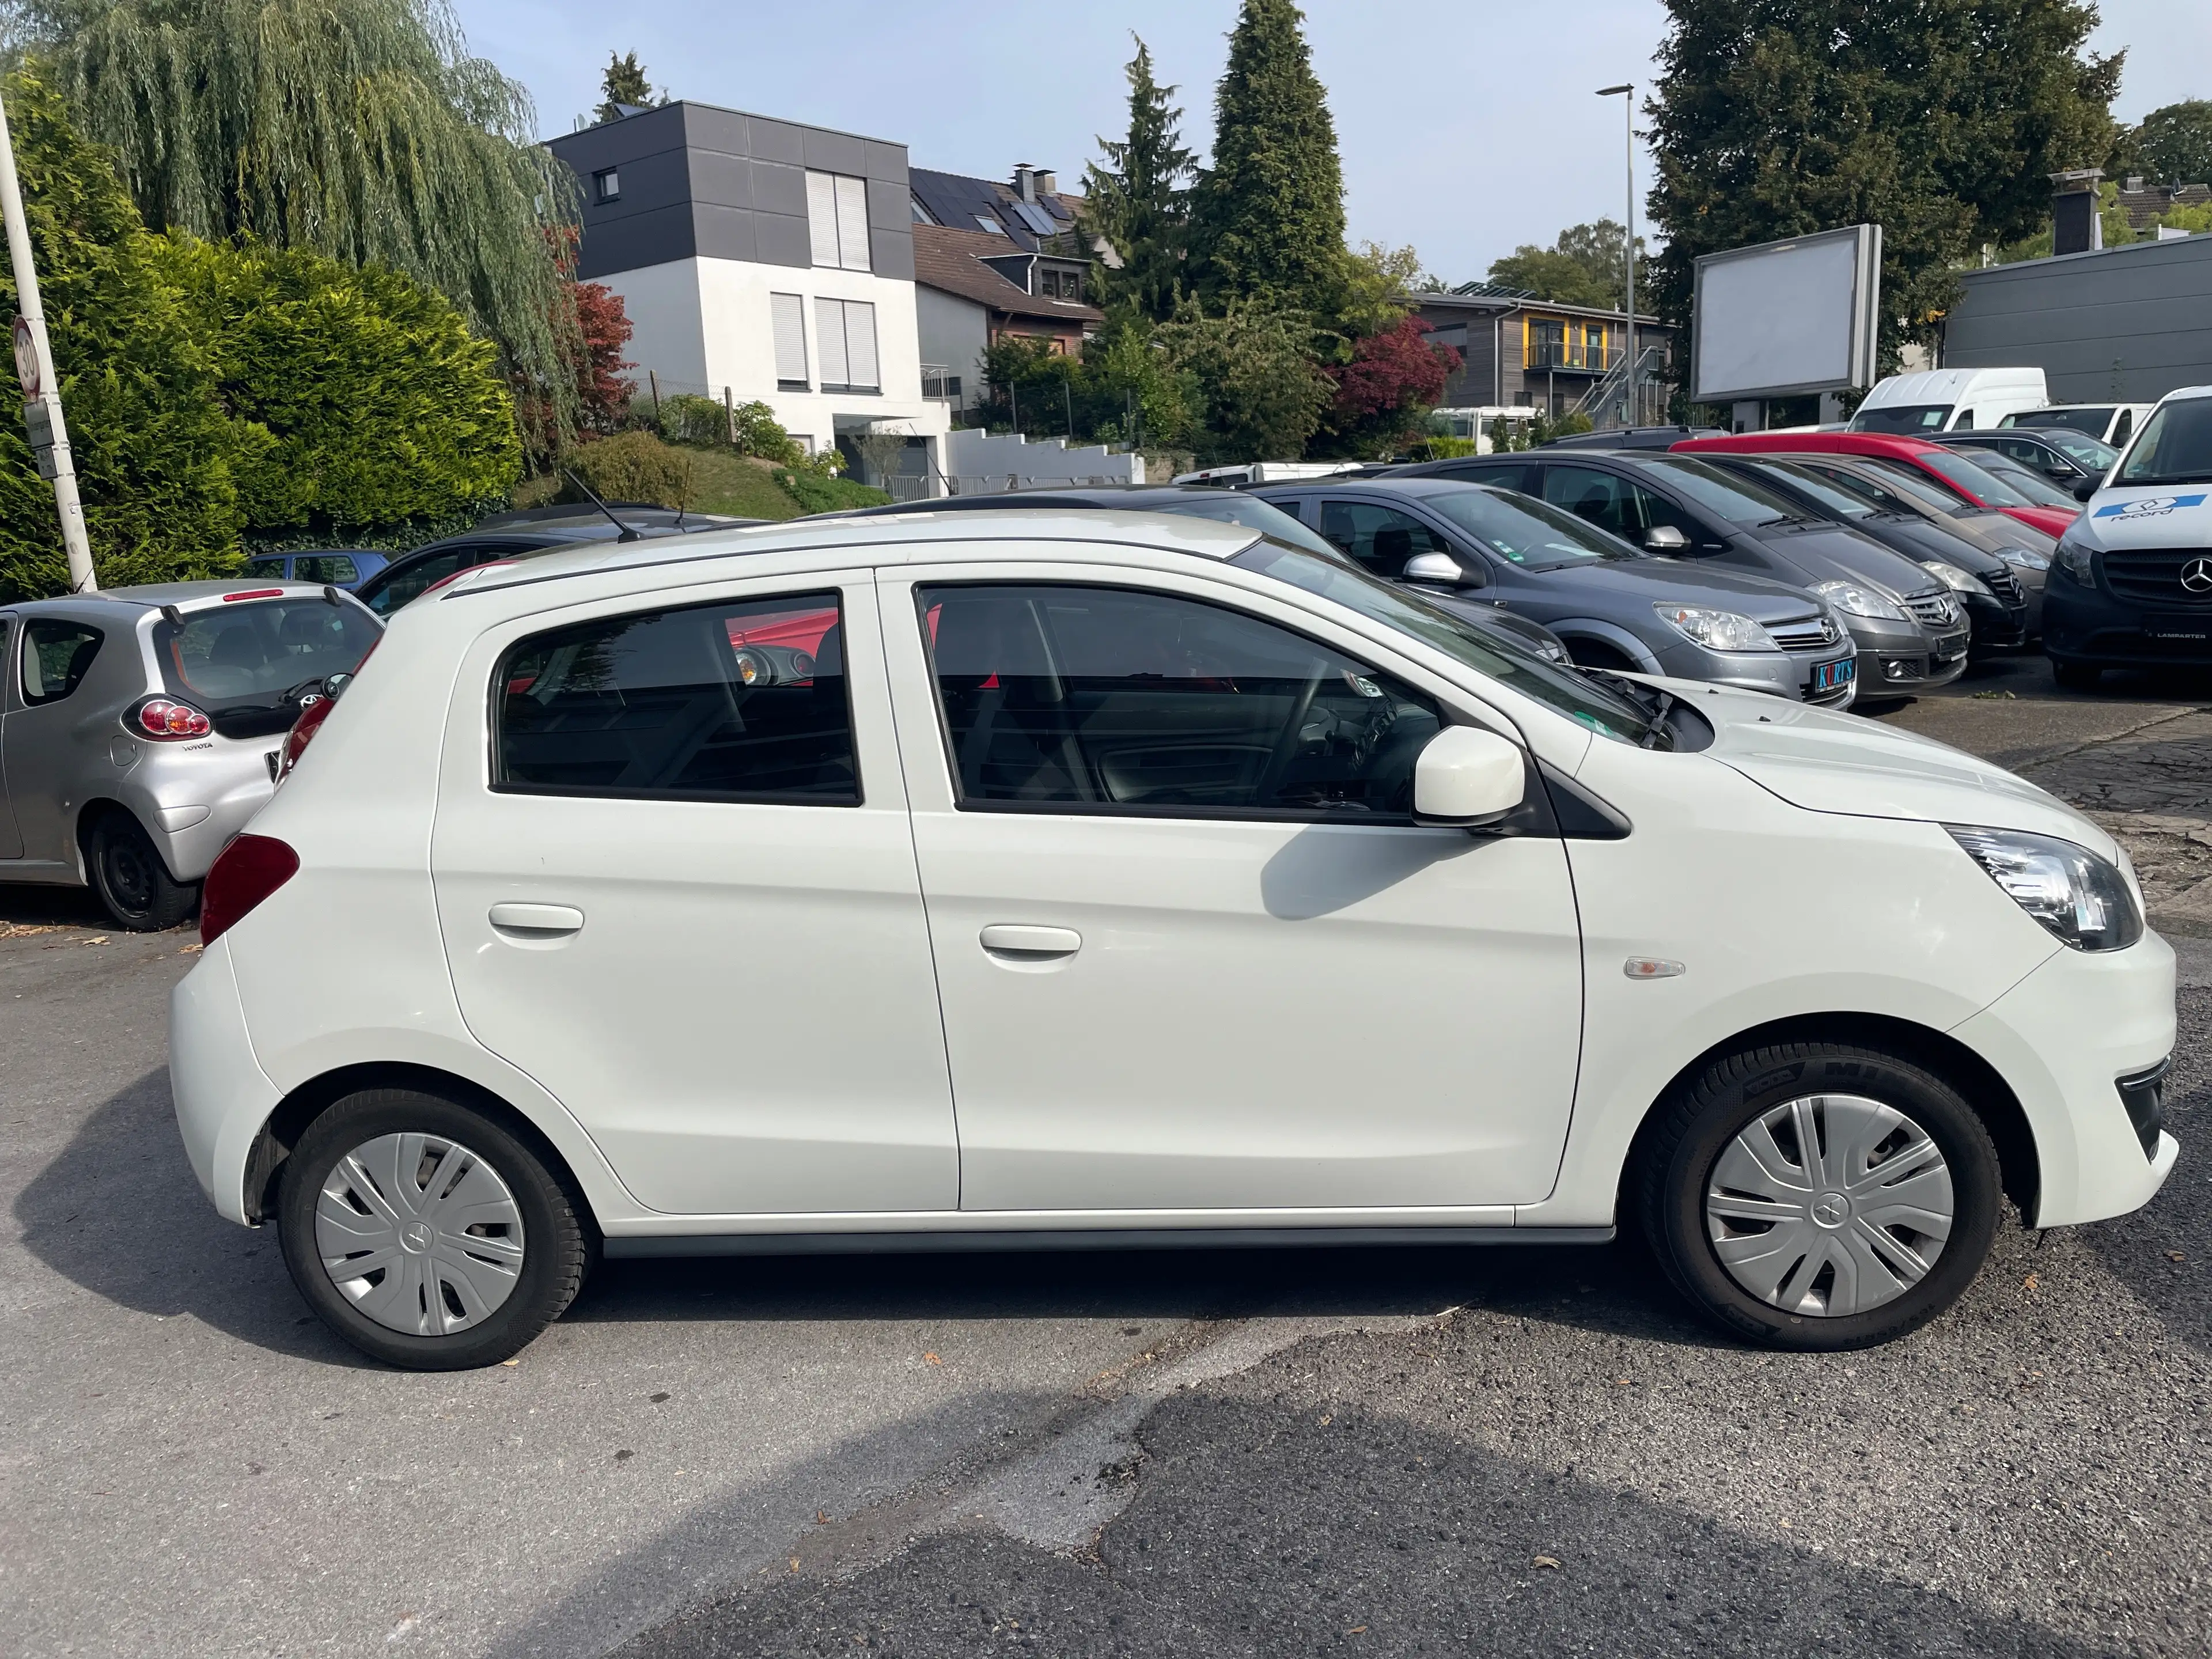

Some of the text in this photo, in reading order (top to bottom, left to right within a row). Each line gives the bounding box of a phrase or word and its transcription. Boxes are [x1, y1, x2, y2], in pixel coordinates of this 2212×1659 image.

[19, 339, 35, 377] 30
[2111, 507, 2174, 522] record
[1819, 659, 1853, 688] KURT'S
[182, 743, 213, 752] TOYOTA
